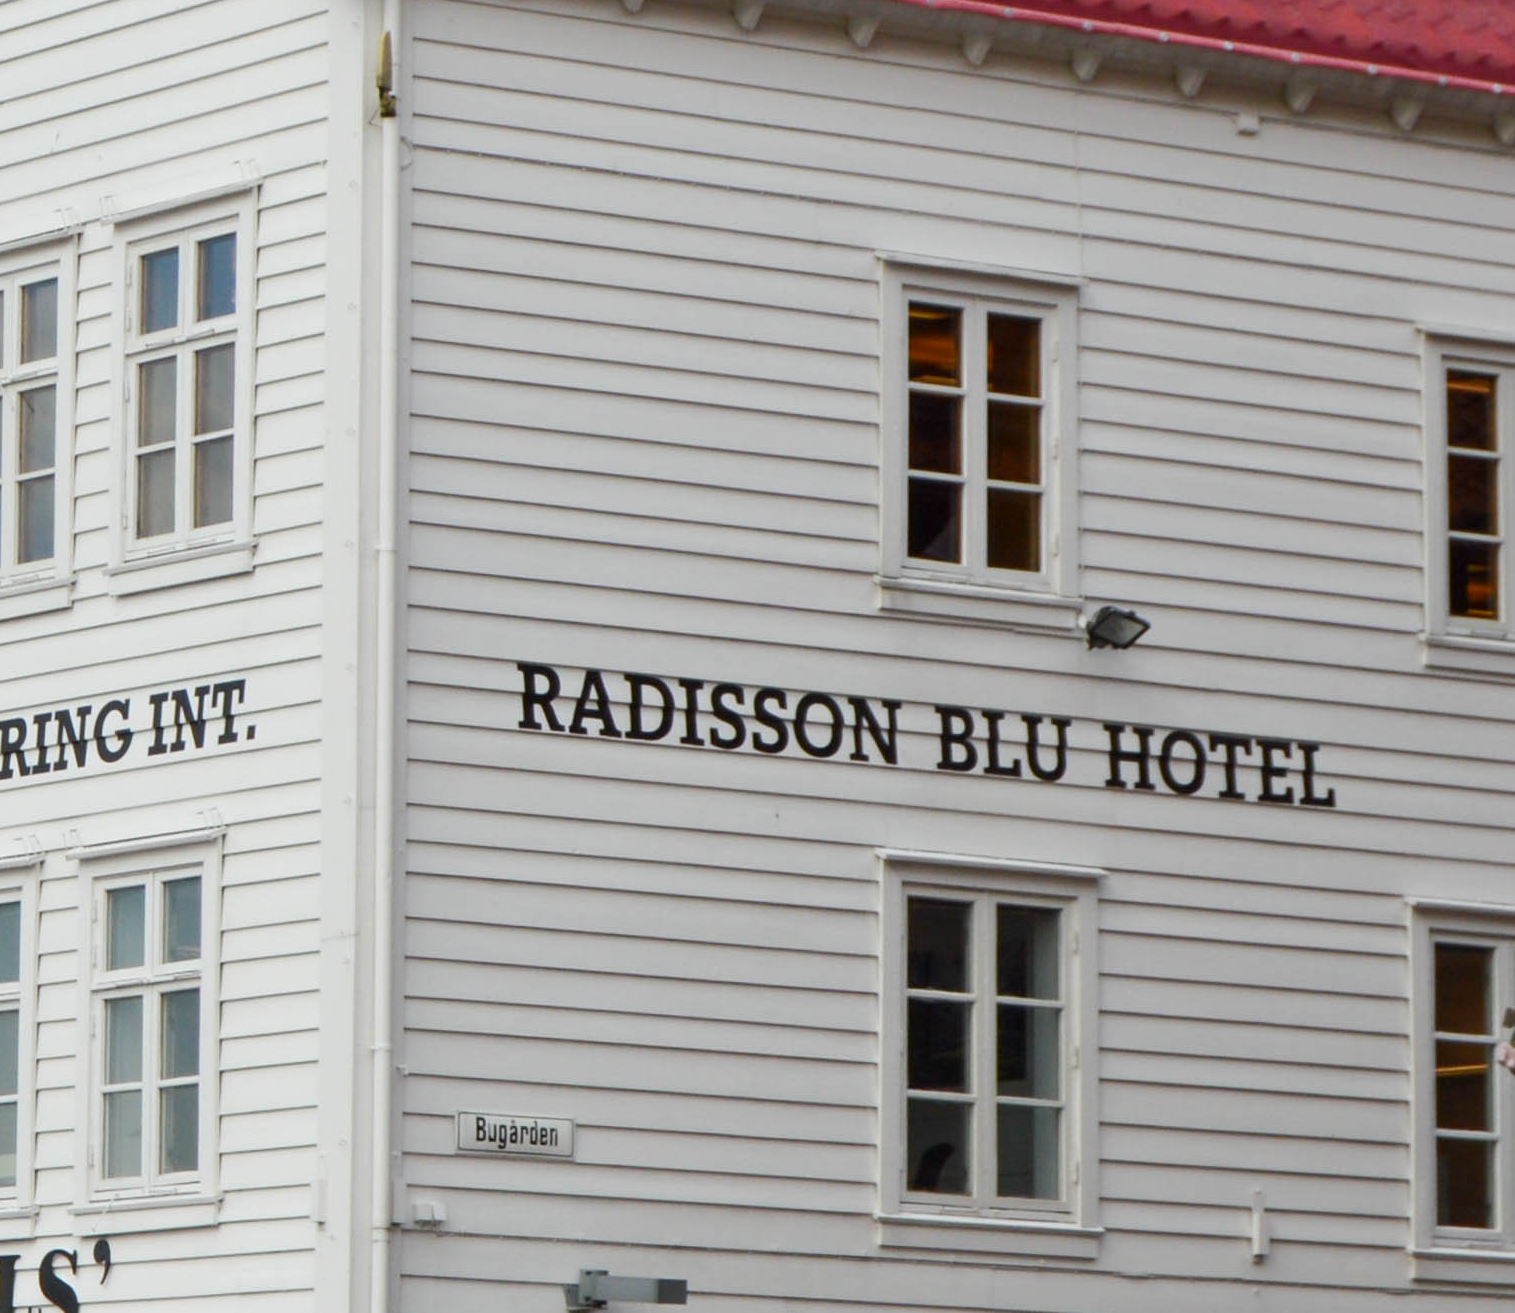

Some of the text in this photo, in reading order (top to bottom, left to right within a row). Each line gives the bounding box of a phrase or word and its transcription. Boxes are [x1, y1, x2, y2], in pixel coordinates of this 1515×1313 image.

[146, 679, 257, 757] INT.
[517, 661, 1336, 807] RADISSON BLU HOTEL
[475, 1116, 559, 1150] Bugården
